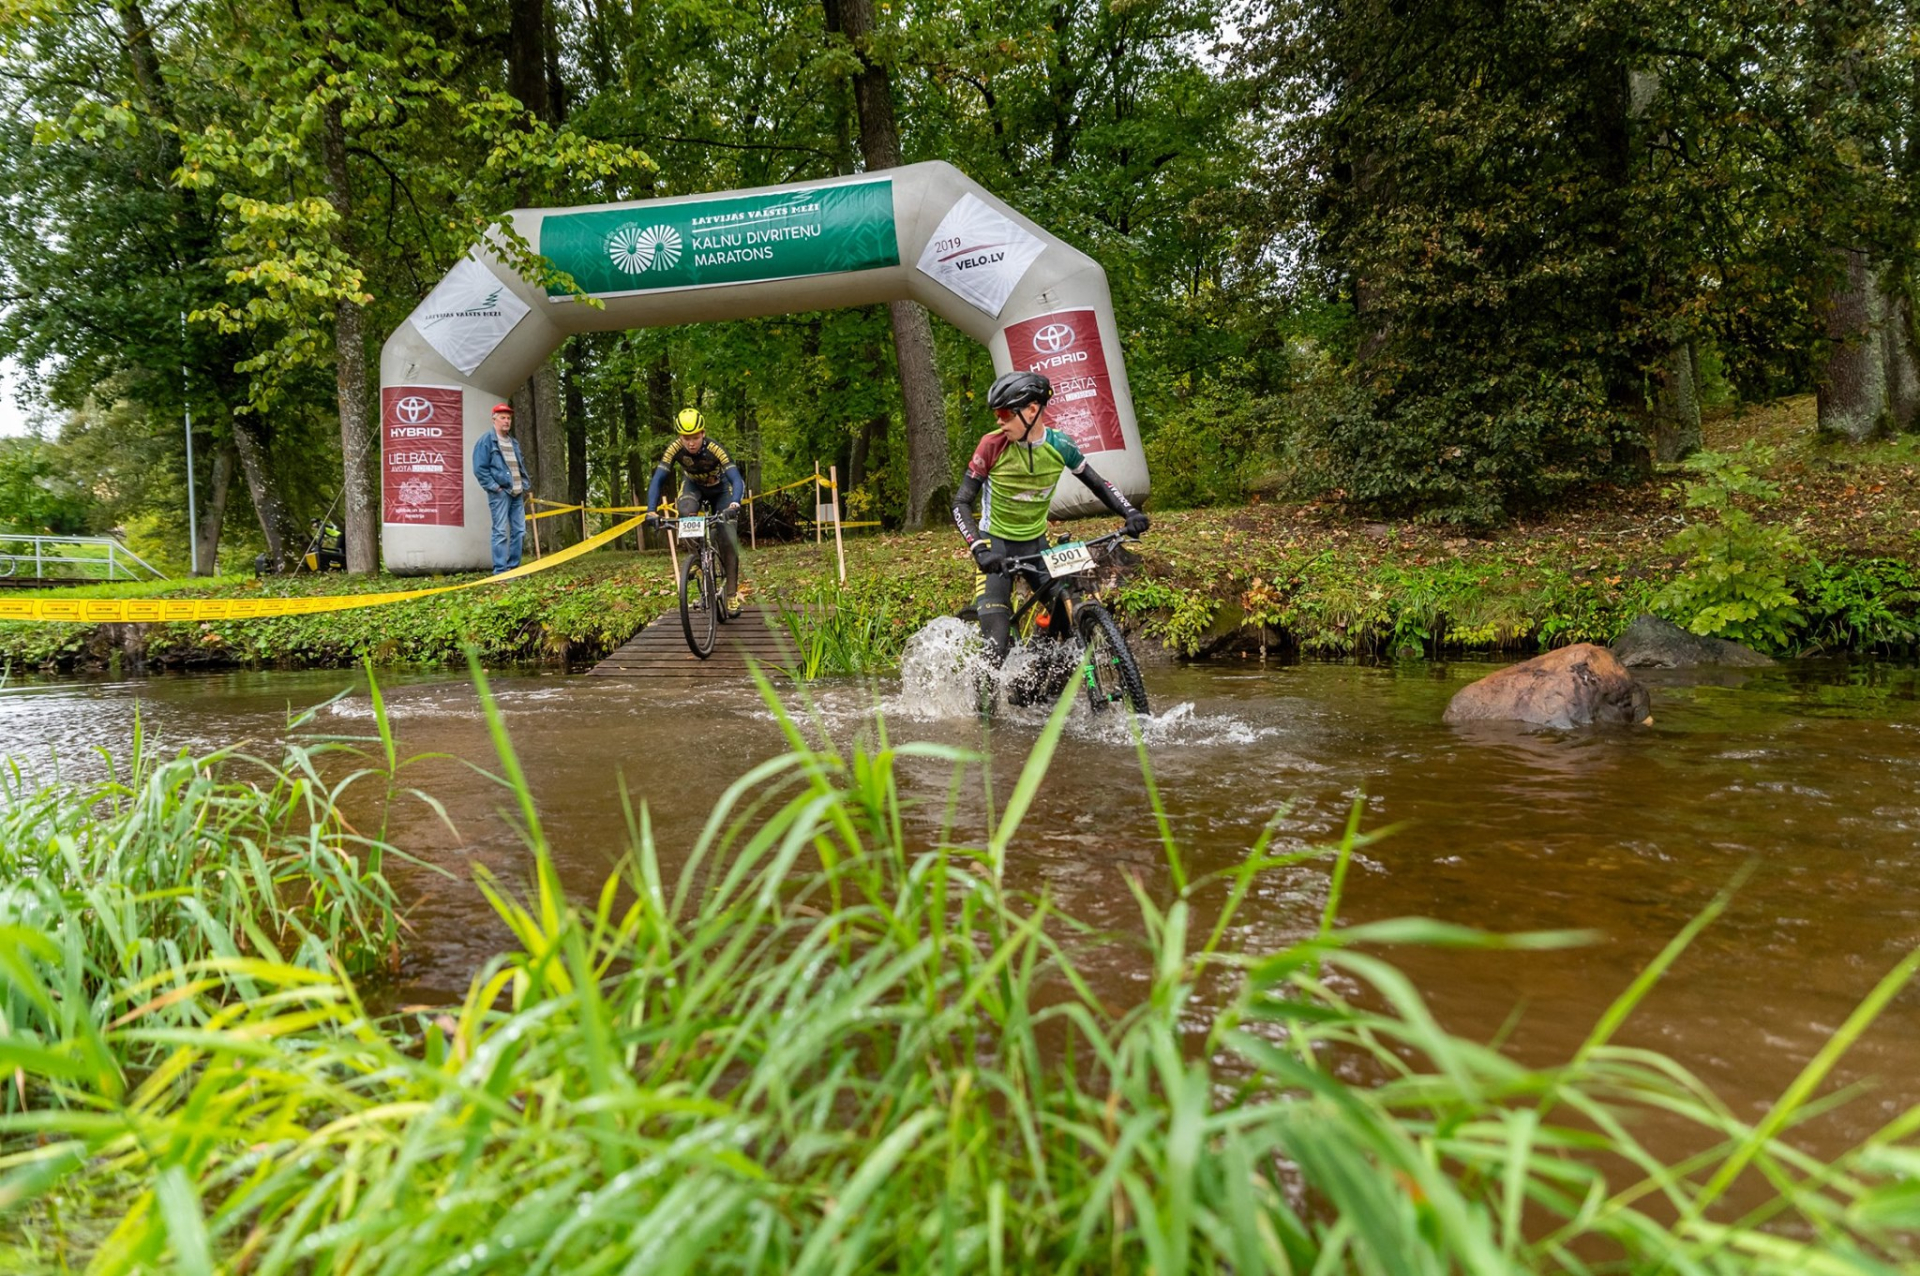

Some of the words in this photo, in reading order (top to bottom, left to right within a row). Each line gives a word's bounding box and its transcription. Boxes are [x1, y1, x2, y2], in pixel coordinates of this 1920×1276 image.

[691, 212, 745, 226] LATVIJAS
[747, 207, 789, 219] VALSTS
[790, 202, 820, 214] MEŽI
[692, 233, 742, 250] KALNU
[746, 223, 821, 245] DIVRITEŅU
[934, 236, 962, 254] 2019
[694, 246, 774, 267] MARATONS
[955, 251, 1005, 271] VELO.LV
[1029, 350, 1088, 373] HYBRID
[1052, 376, 1098, 397] LBĀTA
[390, 427, 443, 438] HYBRID
[388, 450, 446, 465] LIELBĀTA
[682, 521, 701, 530] 5004
[952, 506, 975, 544] ROUBAIX
[1050, 548, 1082, 565] 5001
